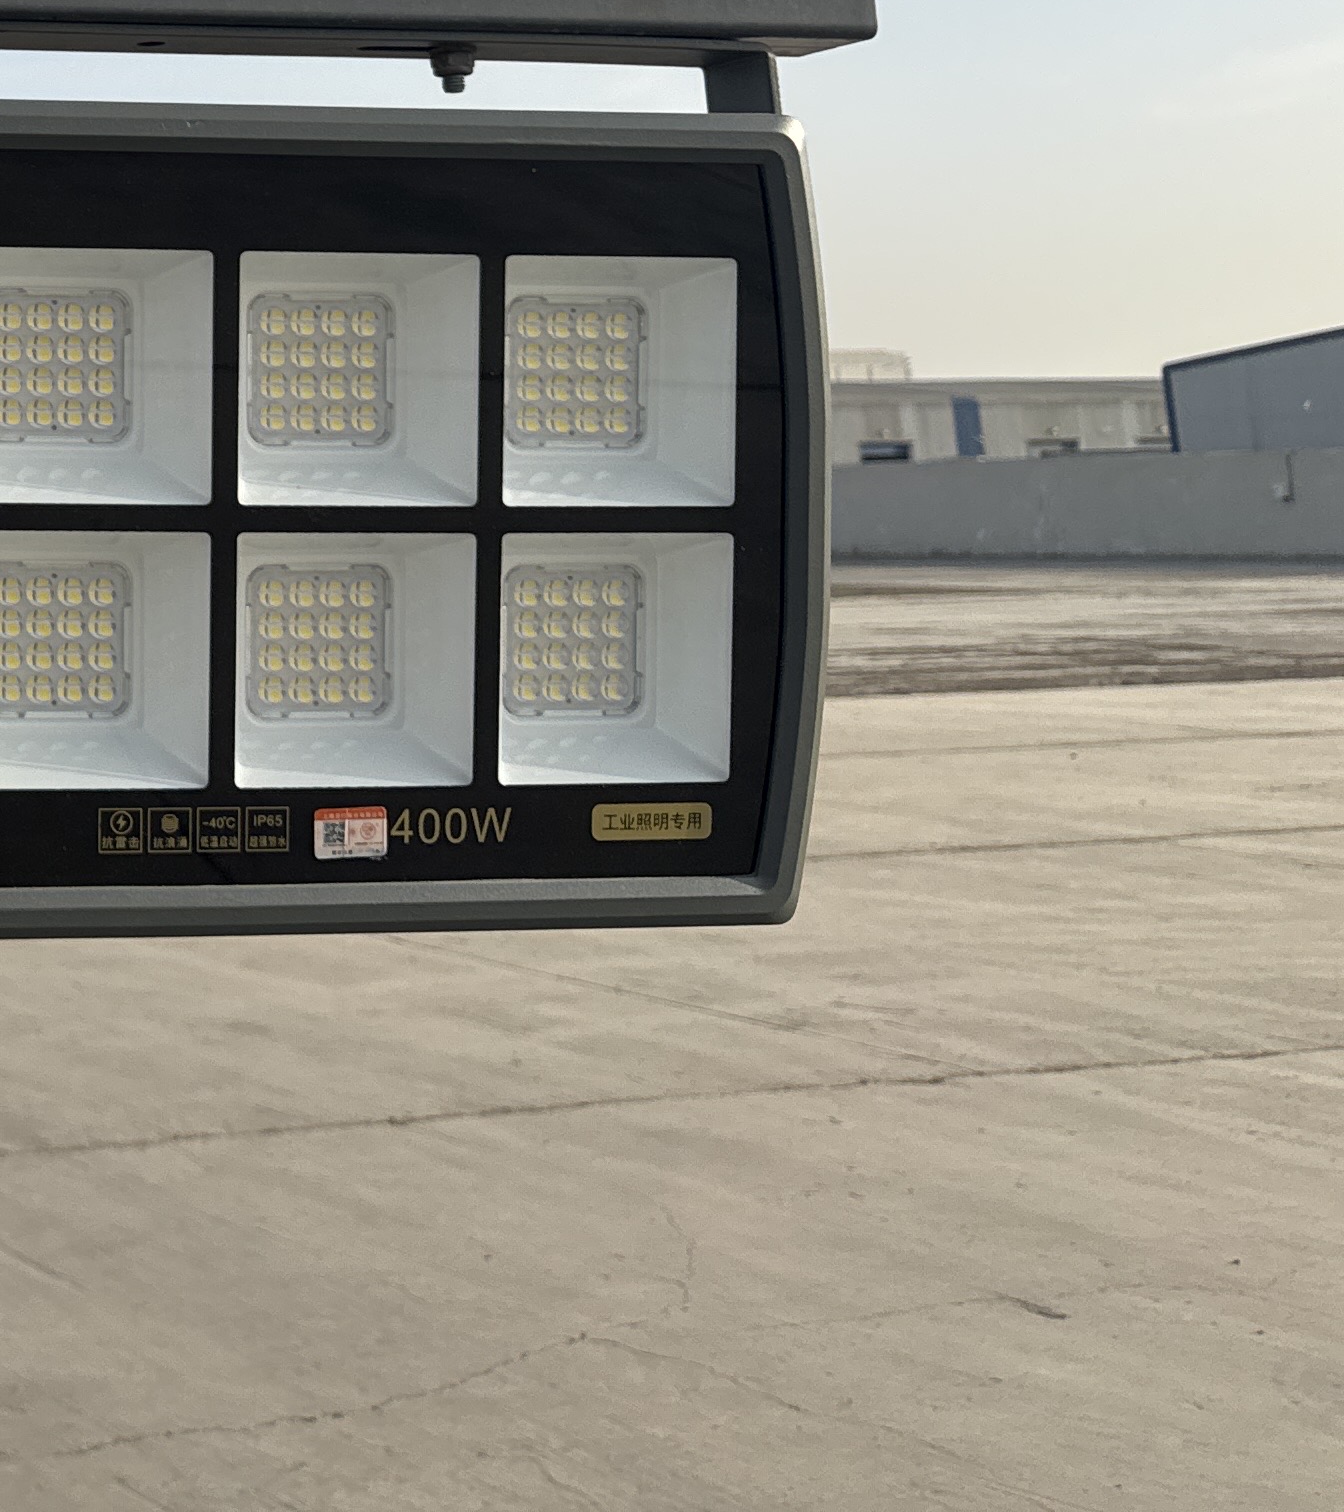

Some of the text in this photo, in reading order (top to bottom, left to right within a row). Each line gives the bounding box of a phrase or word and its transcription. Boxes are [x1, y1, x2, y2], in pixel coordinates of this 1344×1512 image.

[253, 814, 283, 827] IP65
[389, 806, 512, 845] 400W
[601, 810, 703, 832] 工业照明专用
